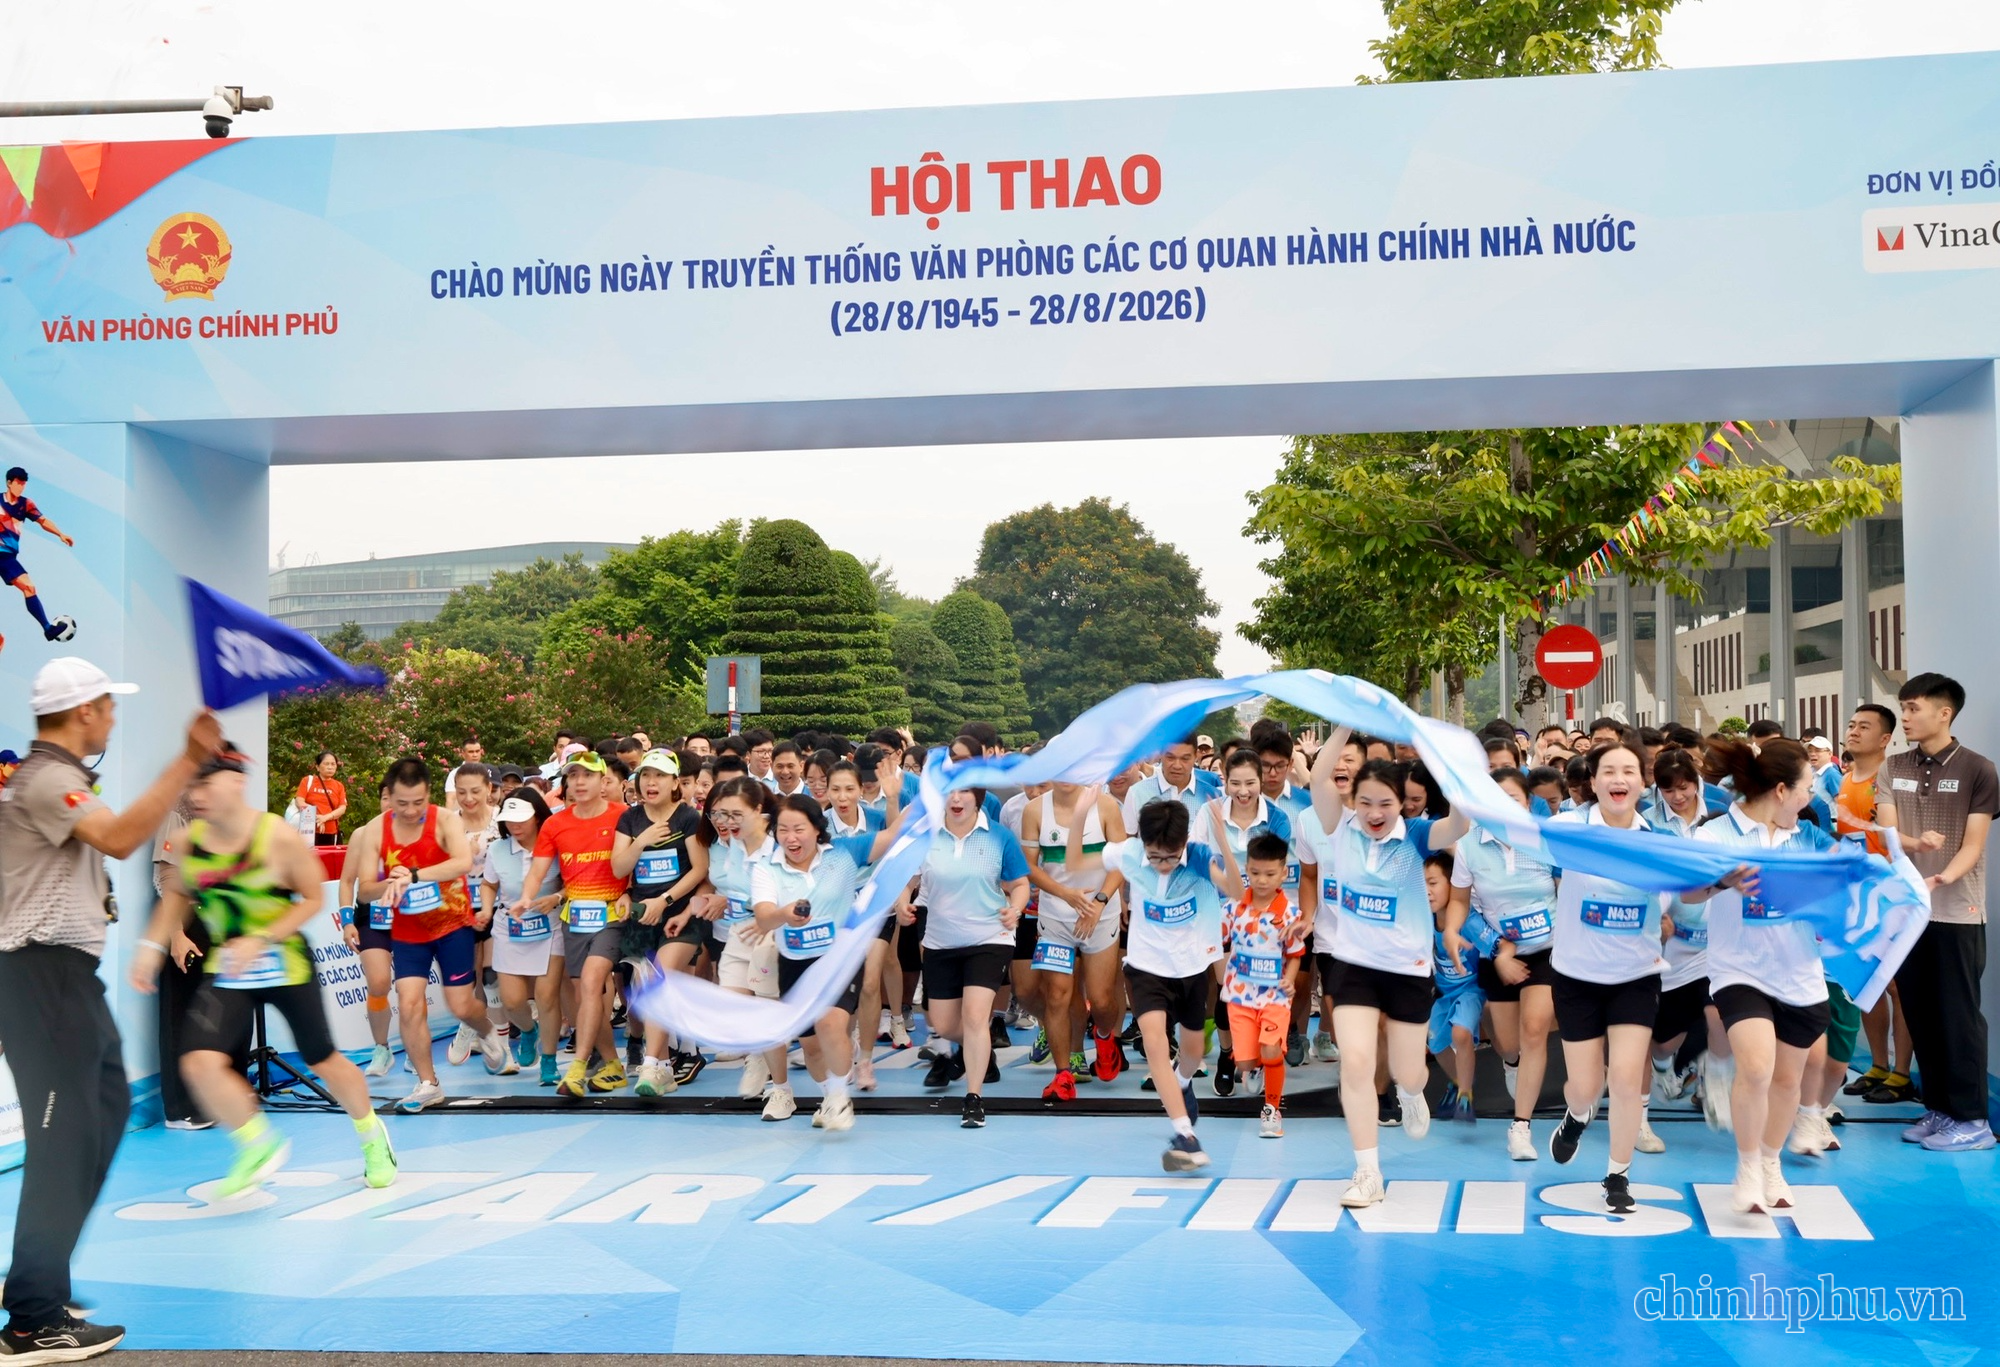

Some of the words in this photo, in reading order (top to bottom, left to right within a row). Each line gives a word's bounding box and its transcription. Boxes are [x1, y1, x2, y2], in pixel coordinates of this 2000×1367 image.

[1866, 170, 1921, 195] ĐƠN
[1927, 170, 1953, 197] VỊ
[1960, 159, 2000, 190] ĐỒ
[871, 151, 971, 231] HỘI
[987, 153, 1162, 211] THAO
[431, 262, 503, 299] CHÀO
[514, 259, 590, 296] MỪNG
[601, 255, 673, 292] NGÀY
[683, 245, 794, 289] TRUYỀN
[805, 243, 900, 284] THỐNG
[911, 244, 966, 280] VĂN
[977, 239, 1073, 277] PHÒNG
[1084, 235, 1139, 273] CÁC
[1150, 237, 1186, 270] CƠ
[1198, 237, 1276, 272] QUAN
[1287, 227, 1367, 265] HÀNH
[1379, 222, 1469, 261] CHÍNH
[1481, 217, 1543, 257] NHÀ
[1554, 214, 1635, 254] NƯỚC
[830, 296, 999, 337] (28/8/1945
[1029, 286, 1206, 326] 28/8/2026)
[42, 320, 95, 343] VĂN
[103, 312, 192, 341] PHÒNG
[199, 309, 279, 339] CHÍNH
[285, 305, 339, 335] PHỦ
[650, 859, 673, 871] N581
[1359, 896, 1390, 912] N492
[579, 909, 602, 921] N577
[1519, 913, 1546, 931] N435
[521, 918, 544, 931] N571
[802, 926, 830, 942] N199
[1047, 945, 1070, 960] N353
[326, 965, 347, 985] CÁC
